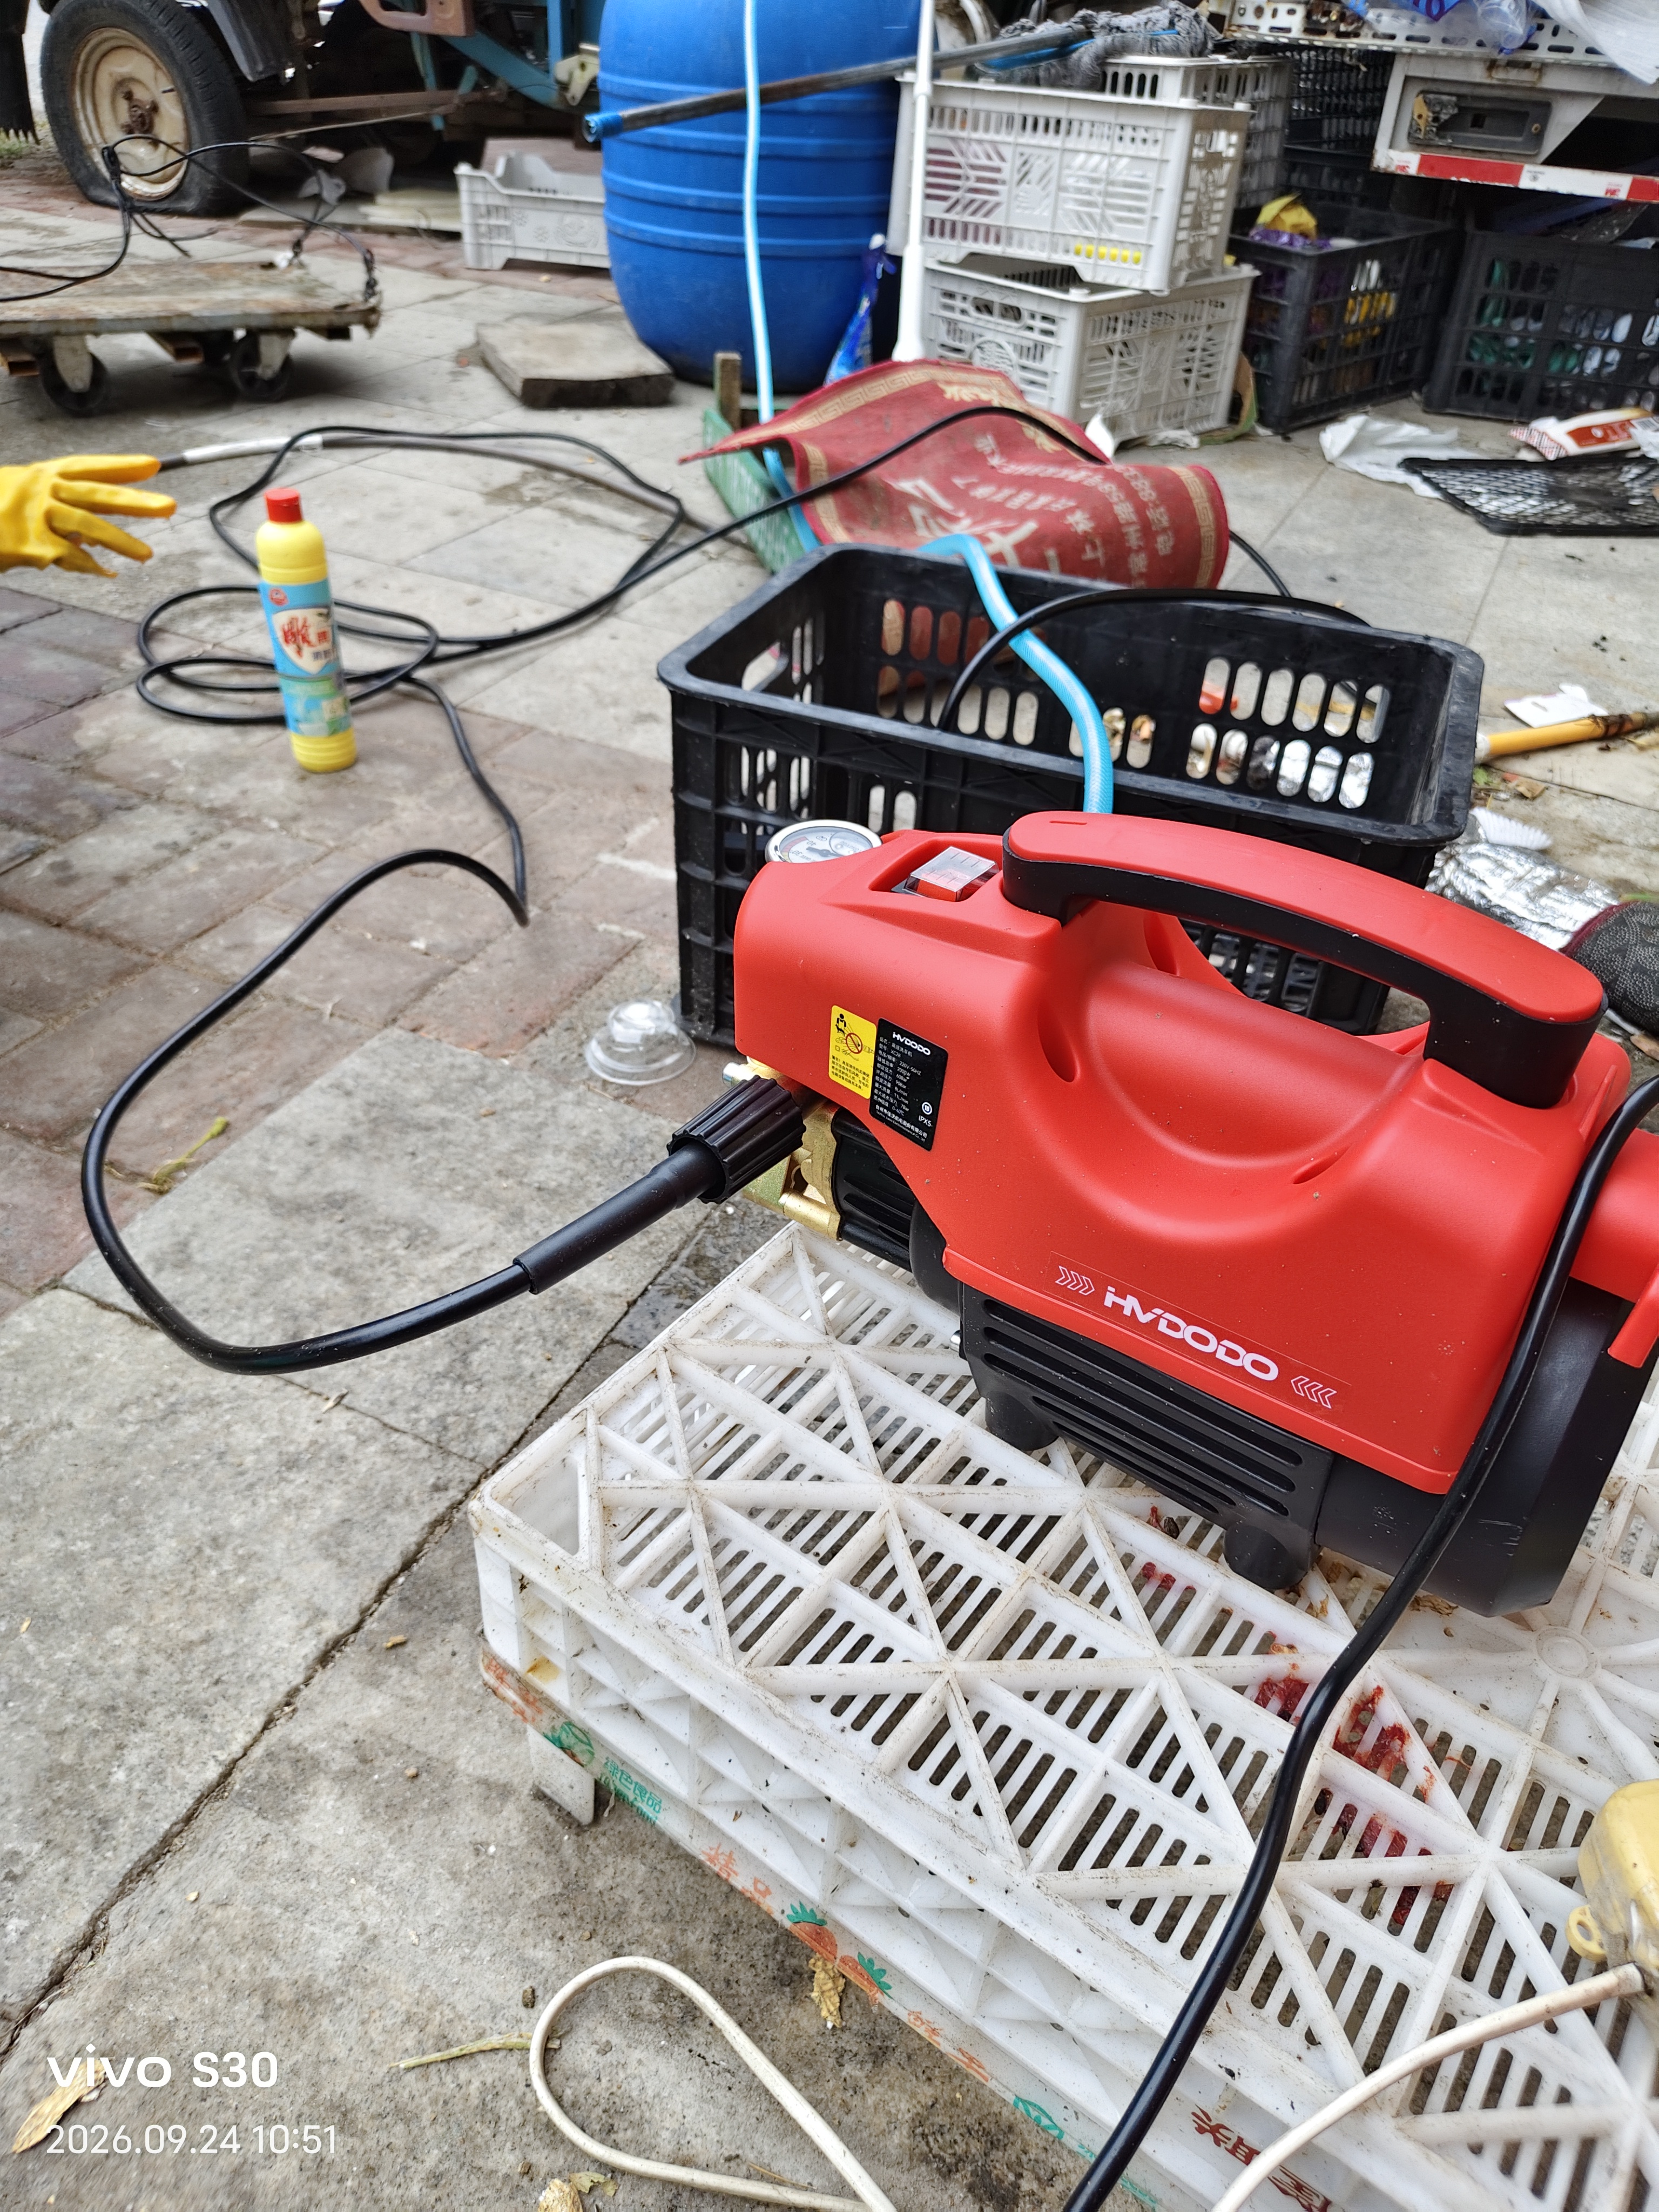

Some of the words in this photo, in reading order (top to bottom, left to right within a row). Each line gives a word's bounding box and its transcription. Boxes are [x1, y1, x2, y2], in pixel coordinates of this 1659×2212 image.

[890, 1048, 901, 1058] XC28
[918, 1114, 932, 1128] IPX5
[604, 1756, 663, 1815] 绿色食品
